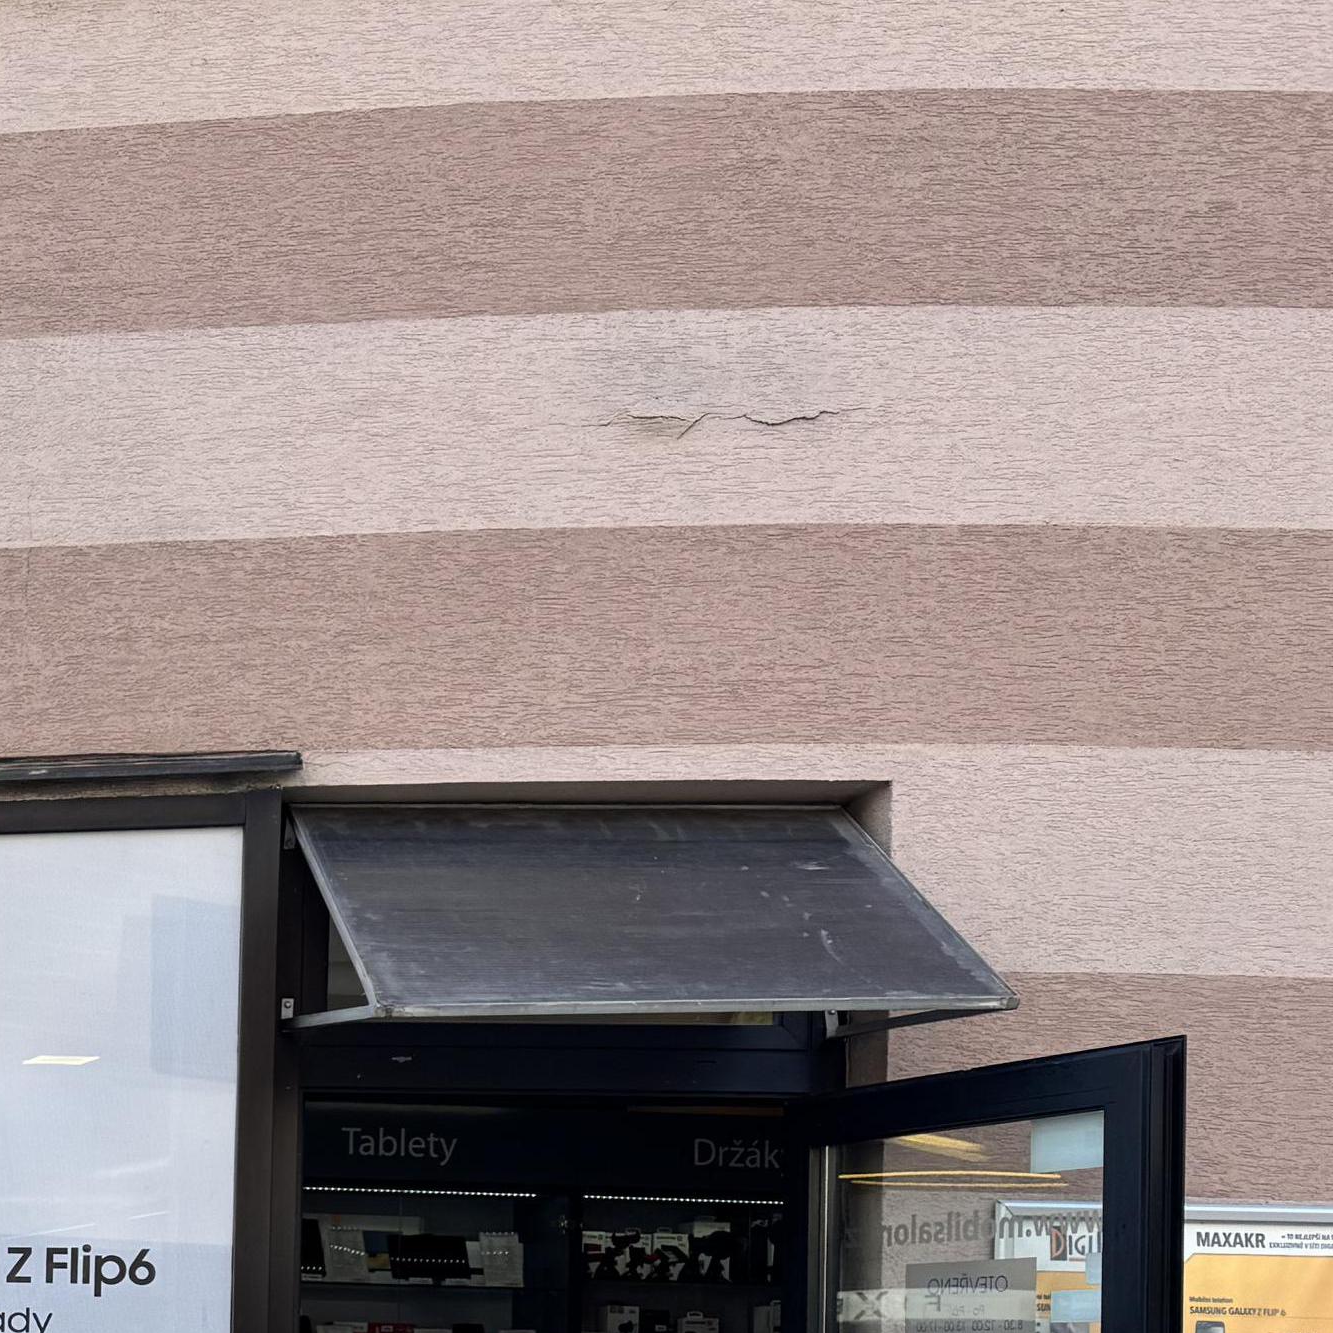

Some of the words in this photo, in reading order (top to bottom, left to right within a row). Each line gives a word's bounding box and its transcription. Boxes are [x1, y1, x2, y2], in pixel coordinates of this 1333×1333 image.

[341, 1127, 457, 1166] Tablety
[693, 1136, 784, 1168] Držák
[1197, 1232, 1265, 1249] MAXAKR
[6, 1247, 32, 1284] Z
[45, 1244, 156, 1297] Flip6
